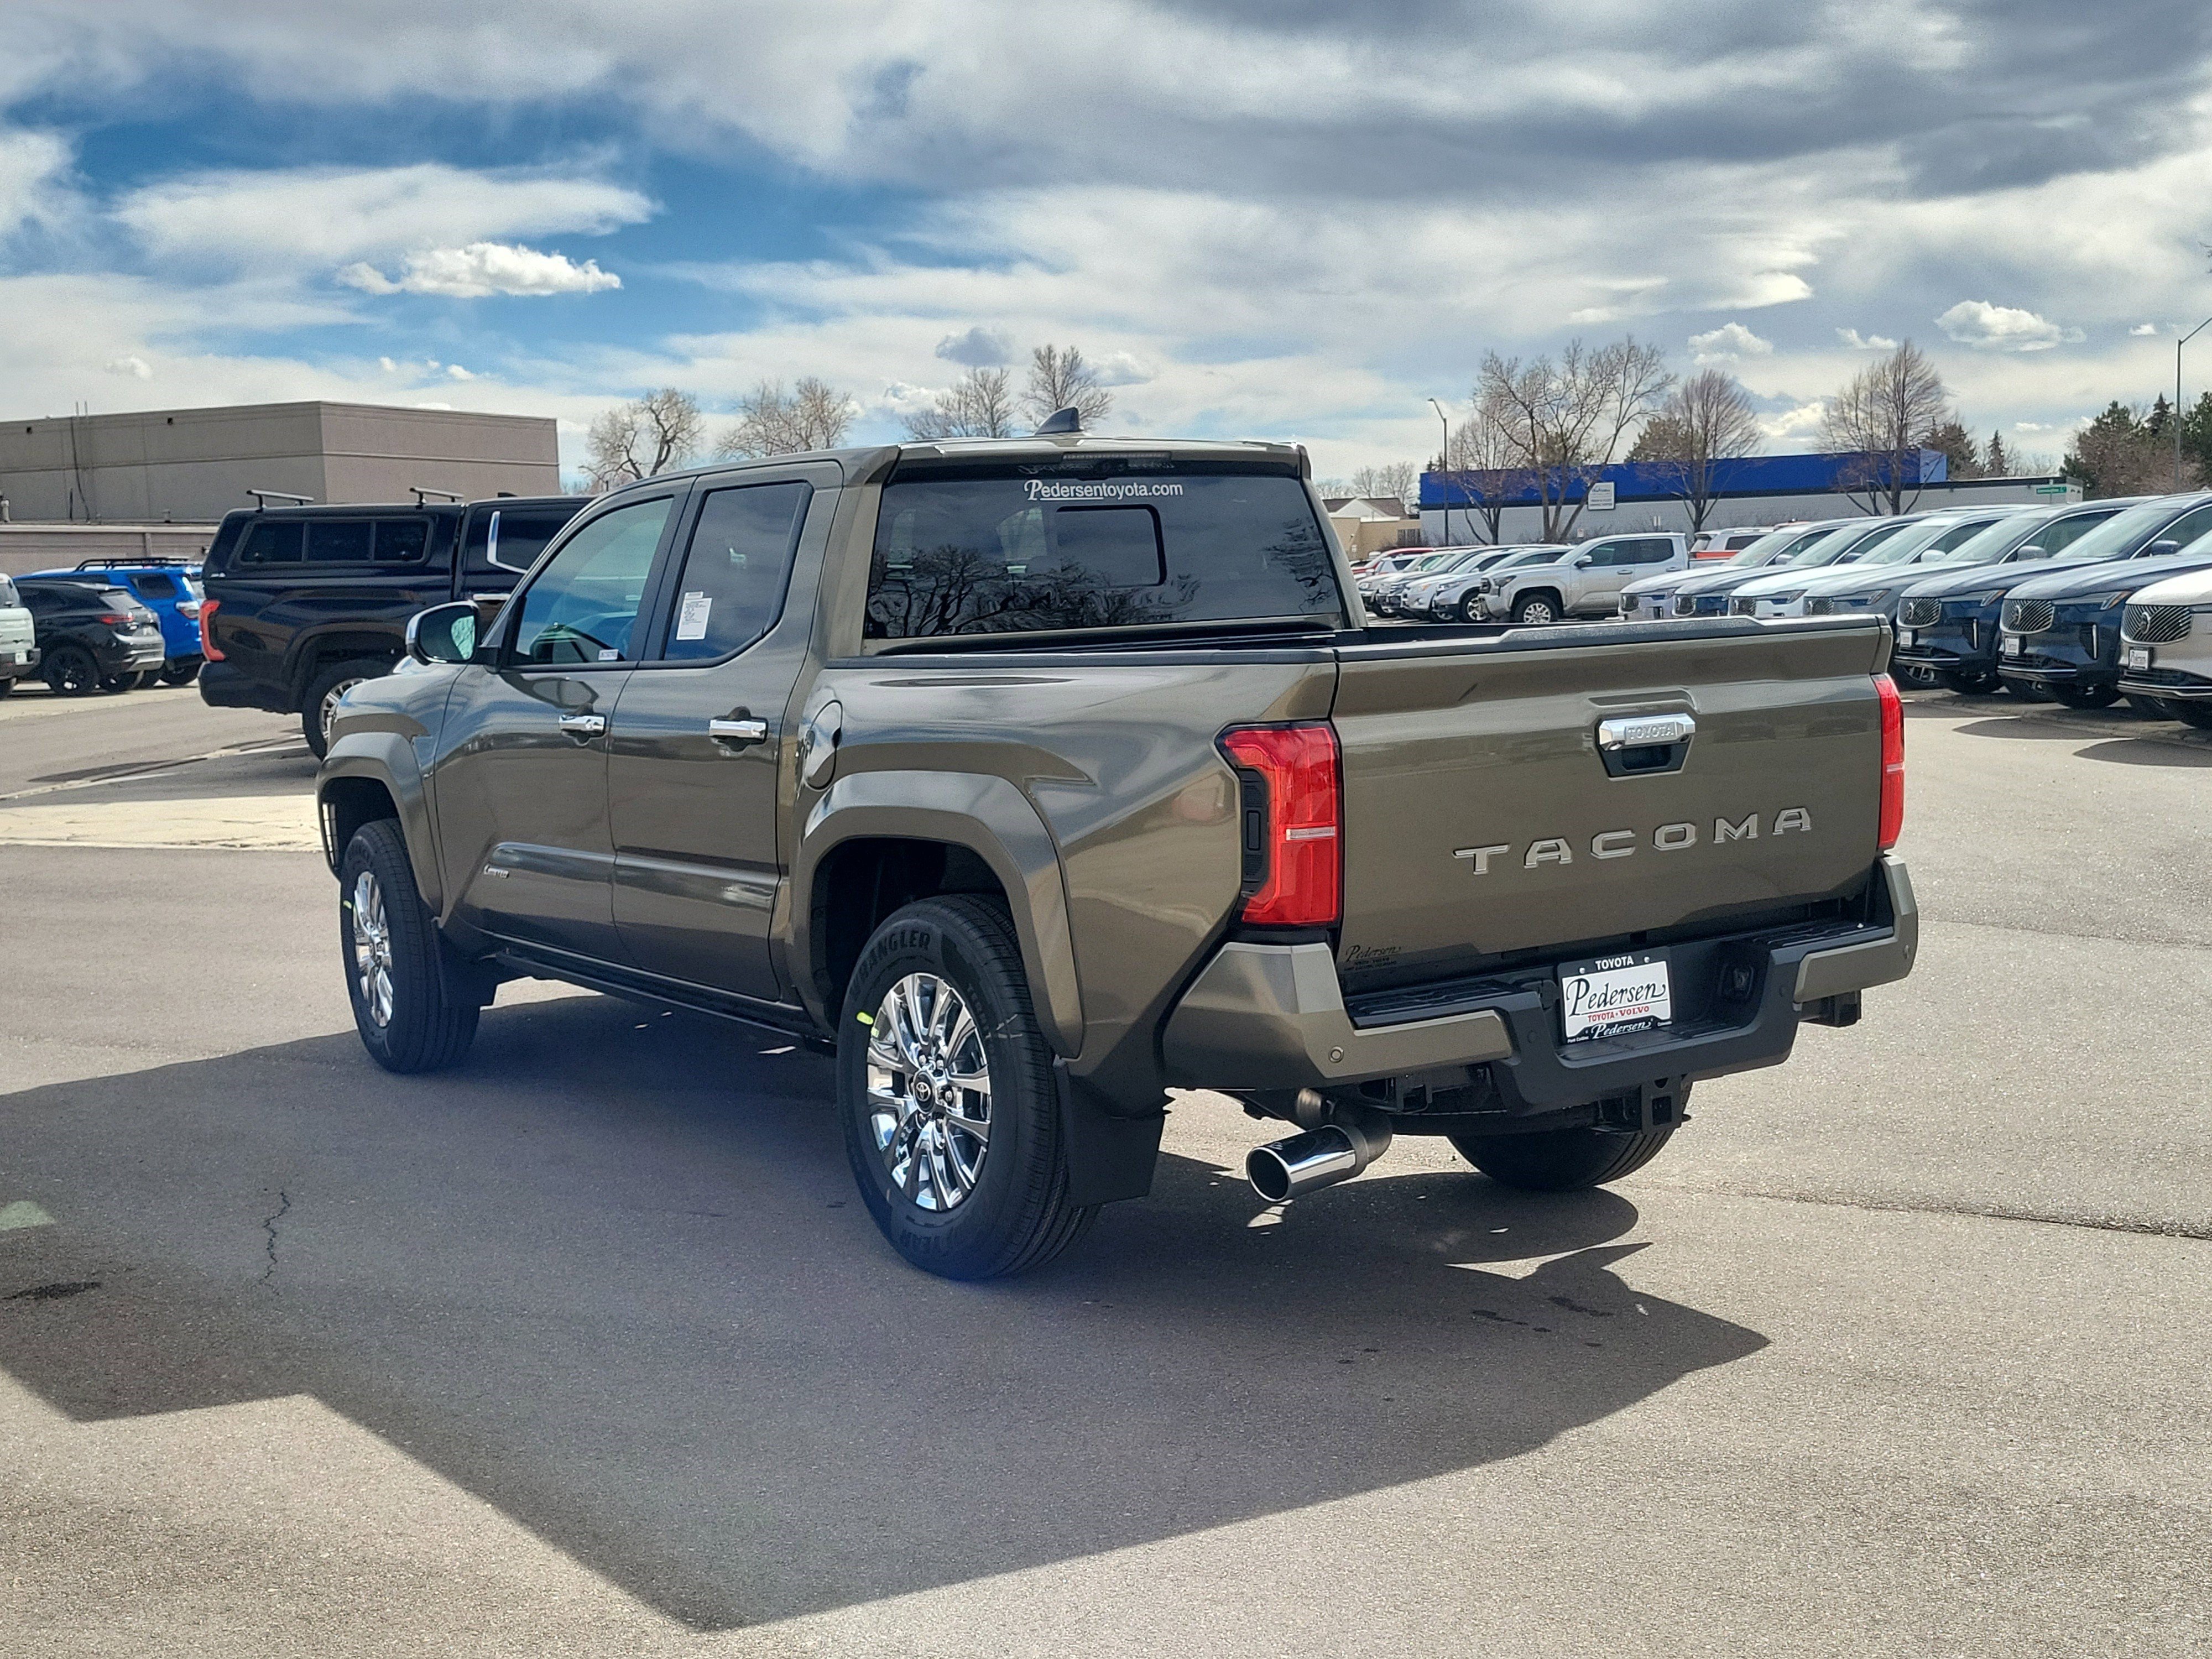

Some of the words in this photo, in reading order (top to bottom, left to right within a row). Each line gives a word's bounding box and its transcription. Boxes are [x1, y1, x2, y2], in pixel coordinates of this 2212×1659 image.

[1024, 479, 1183, 501] Pedersentoyota.com
[1628, 724, 1674, 739] TOYOTA
[1452, 807, 1811, 875] TACOMA
[1595, 956, 1634, 970] TOYOTA
[1567, 978, 1666, 1017] Pedersen
[1591, 1021, 1652, 1039] Pedersen
